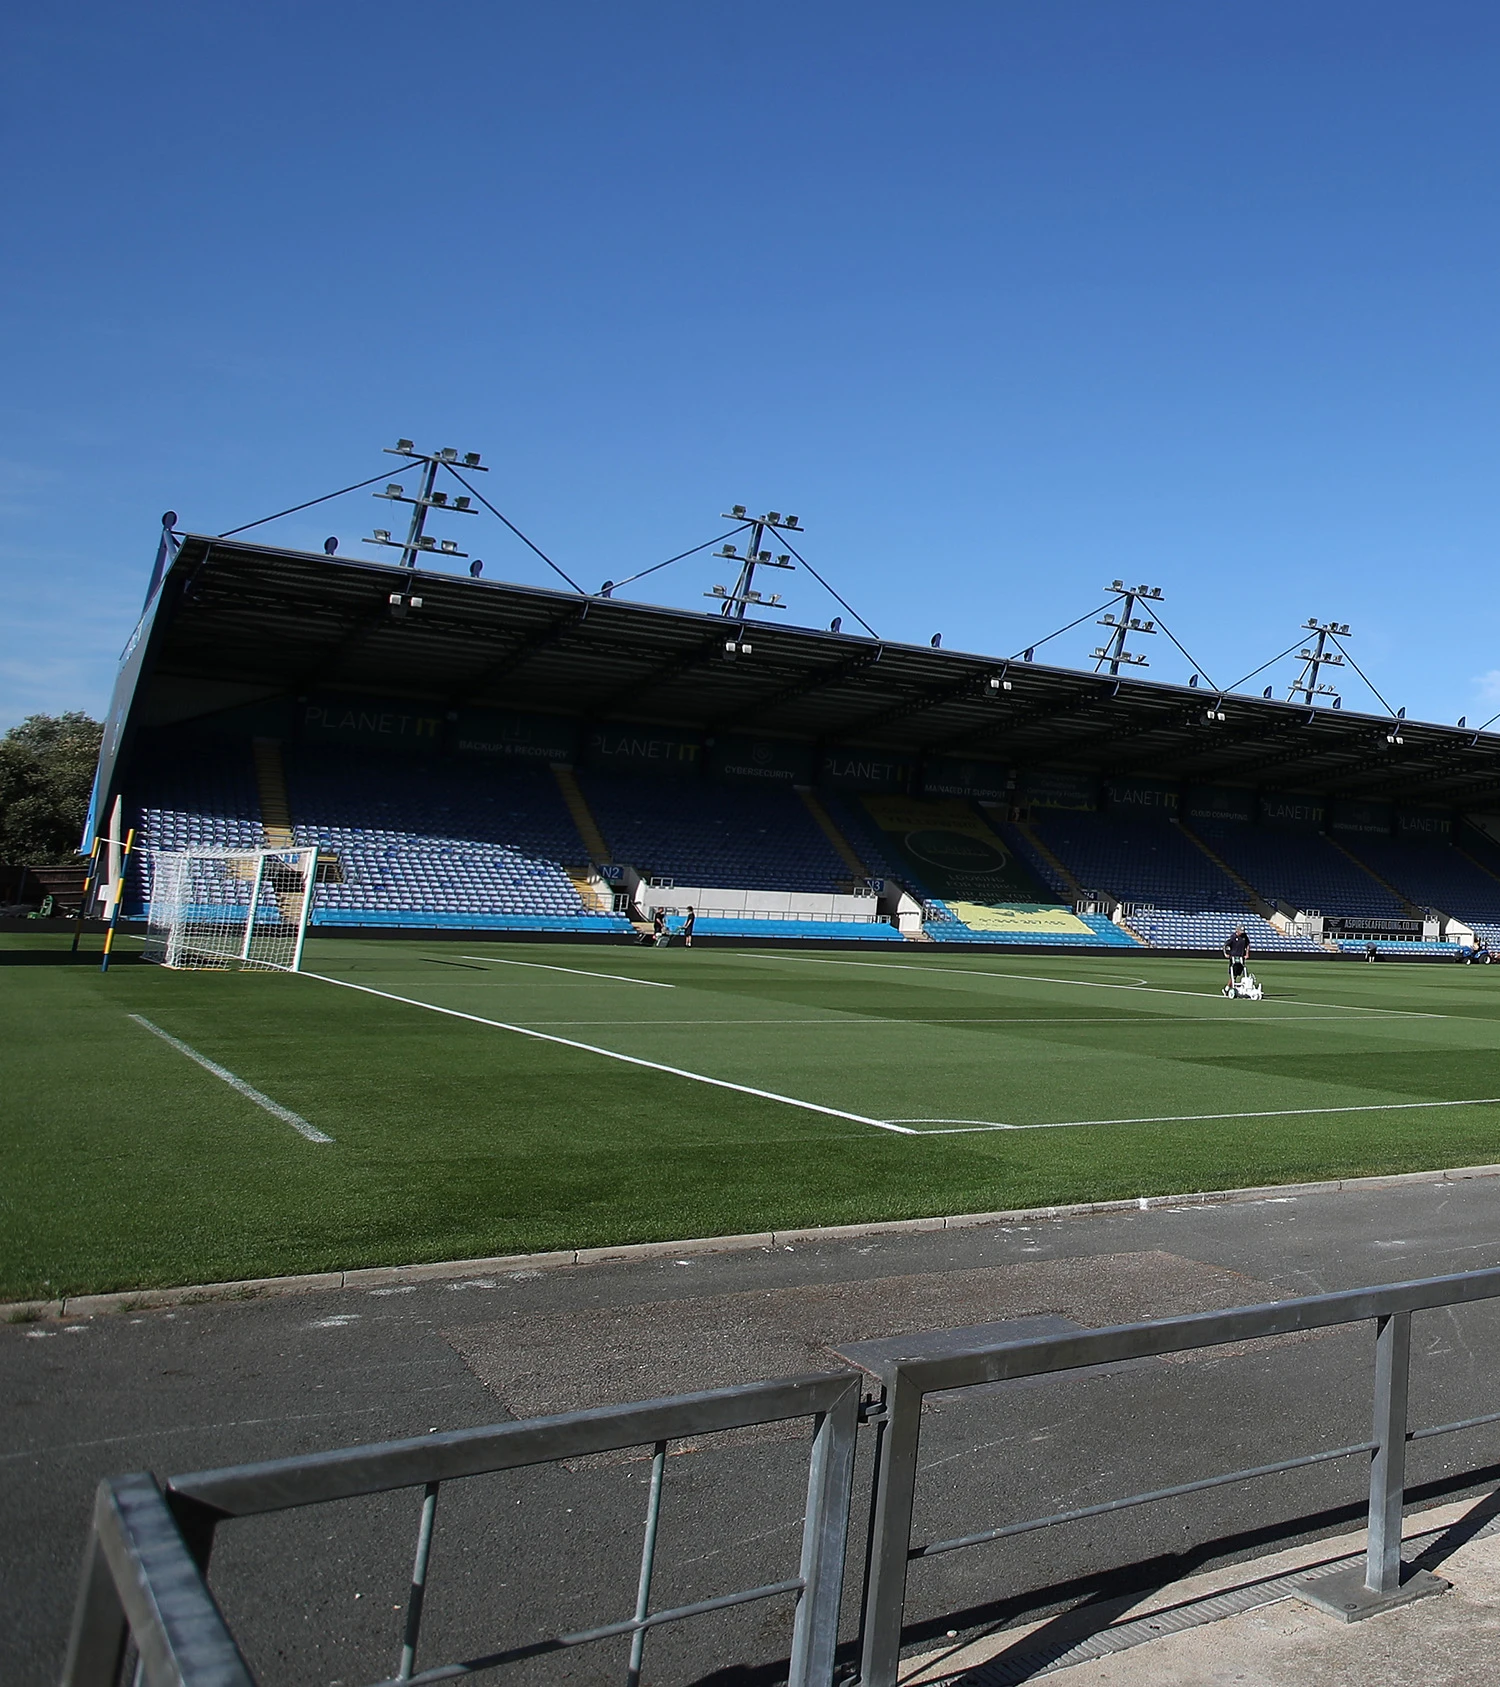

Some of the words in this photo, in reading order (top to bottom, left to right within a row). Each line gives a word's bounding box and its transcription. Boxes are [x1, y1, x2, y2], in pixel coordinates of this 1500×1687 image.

[304, 704, 412, 735] PLANET
[415, 716, 443, 739] IT
[458, 739, 502, 753] BACKUP
[504, 744, 512, 754] &
[514, 745, 569, 759] RECOVERY
[590, 734, 675, 759] PLANET
[677, 743, 700, 762] IT
[724, 764, 796, 779] CYBERSECURITY
[924, 784, 962, 795] MANAGED
[1108, 787, 1164, 807] PLANET
[1190, 808, 1210, 818] CLOUD
[1211, 810, 1248, 821] COMPUTING
[1263, 802, 1311, 820] PLANET
[1399, 815, 1440, 832] PLANET
[602, 866, 620, 879] N2
[866, 880, 881, 891] N3
[1344, 919, 1419, 931] ASPIRESCAFFOLDING.CO.UK
